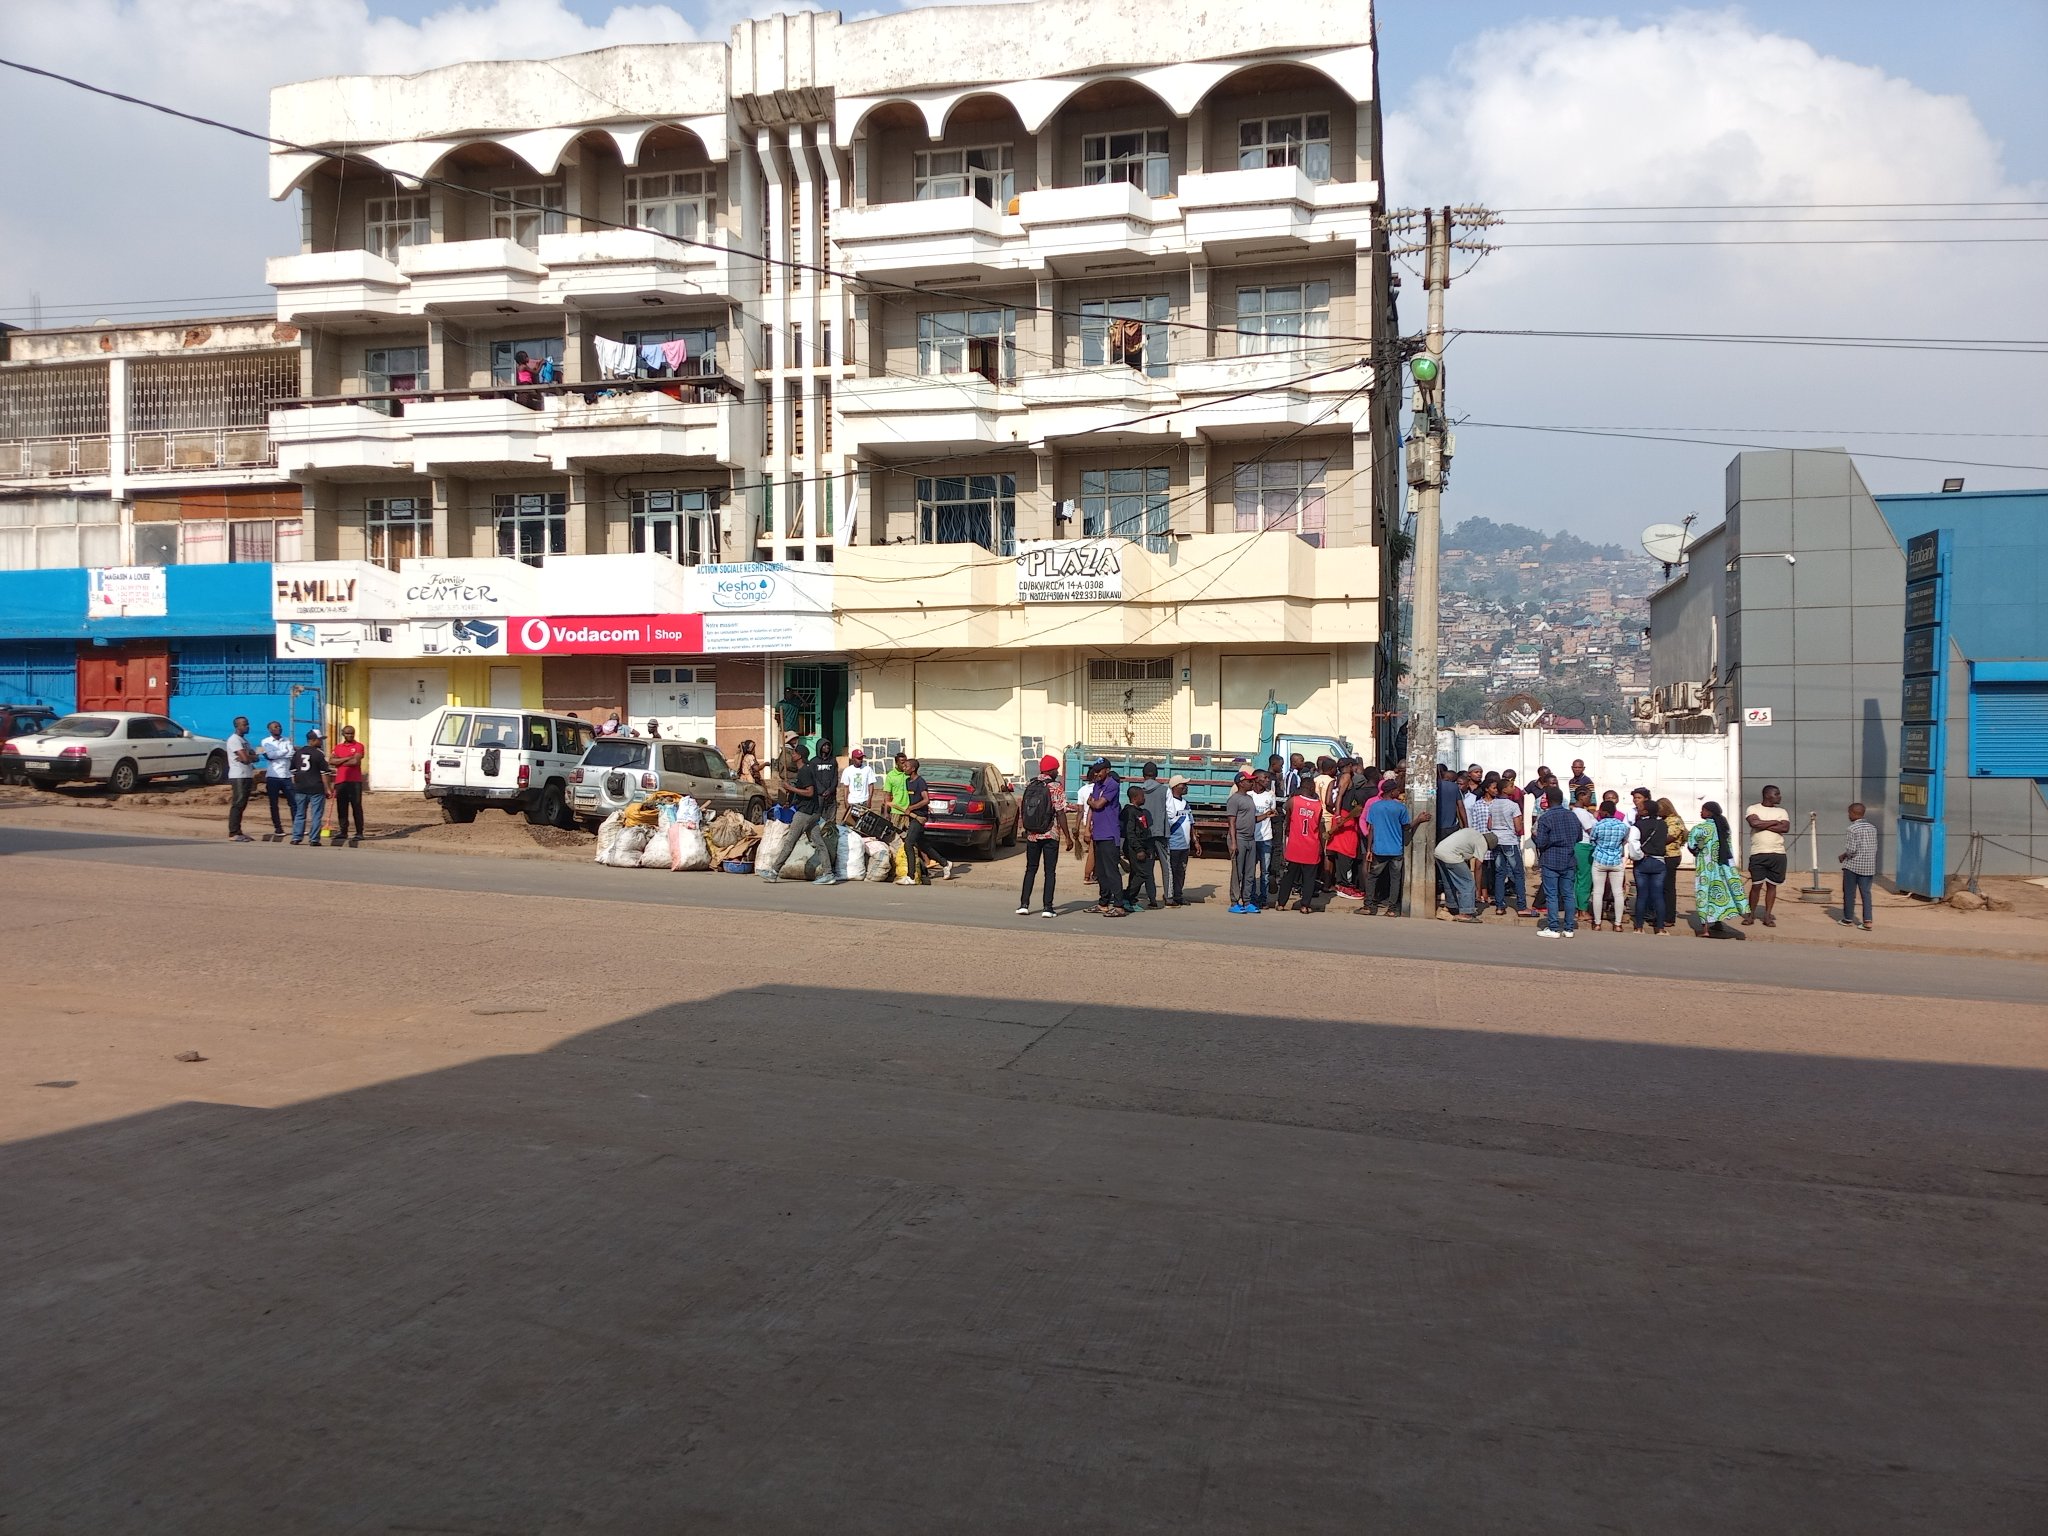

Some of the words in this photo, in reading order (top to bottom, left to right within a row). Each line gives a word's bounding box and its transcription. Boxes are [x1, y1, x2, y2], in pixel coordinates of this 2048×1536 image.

[1028, 548, 1120, 577] PLAZA
[1909, 545, 1936, 566] Ecobank
[104, 573, 128, 581] MAGASIN
[134, 573, 151, 581] LOUER
[697, 565, 718, 574] ACTION
[720, 564, 743, 574] SOCIALE
[744, 563, 764, 573] KESHO
[277, 578, 357, 604] FAMILLY
[406, 586, 498, 603] CENTER
[718, 580, 757, 592] Kesho
[1098, 590, 1121, 600] BUKAVU
[553, 627, 640, 642] Vodacom
[655, 629, 683, 642] Shop
[301, 754, 311, 771] 3
[1302, 818, 1309, 836] 1
